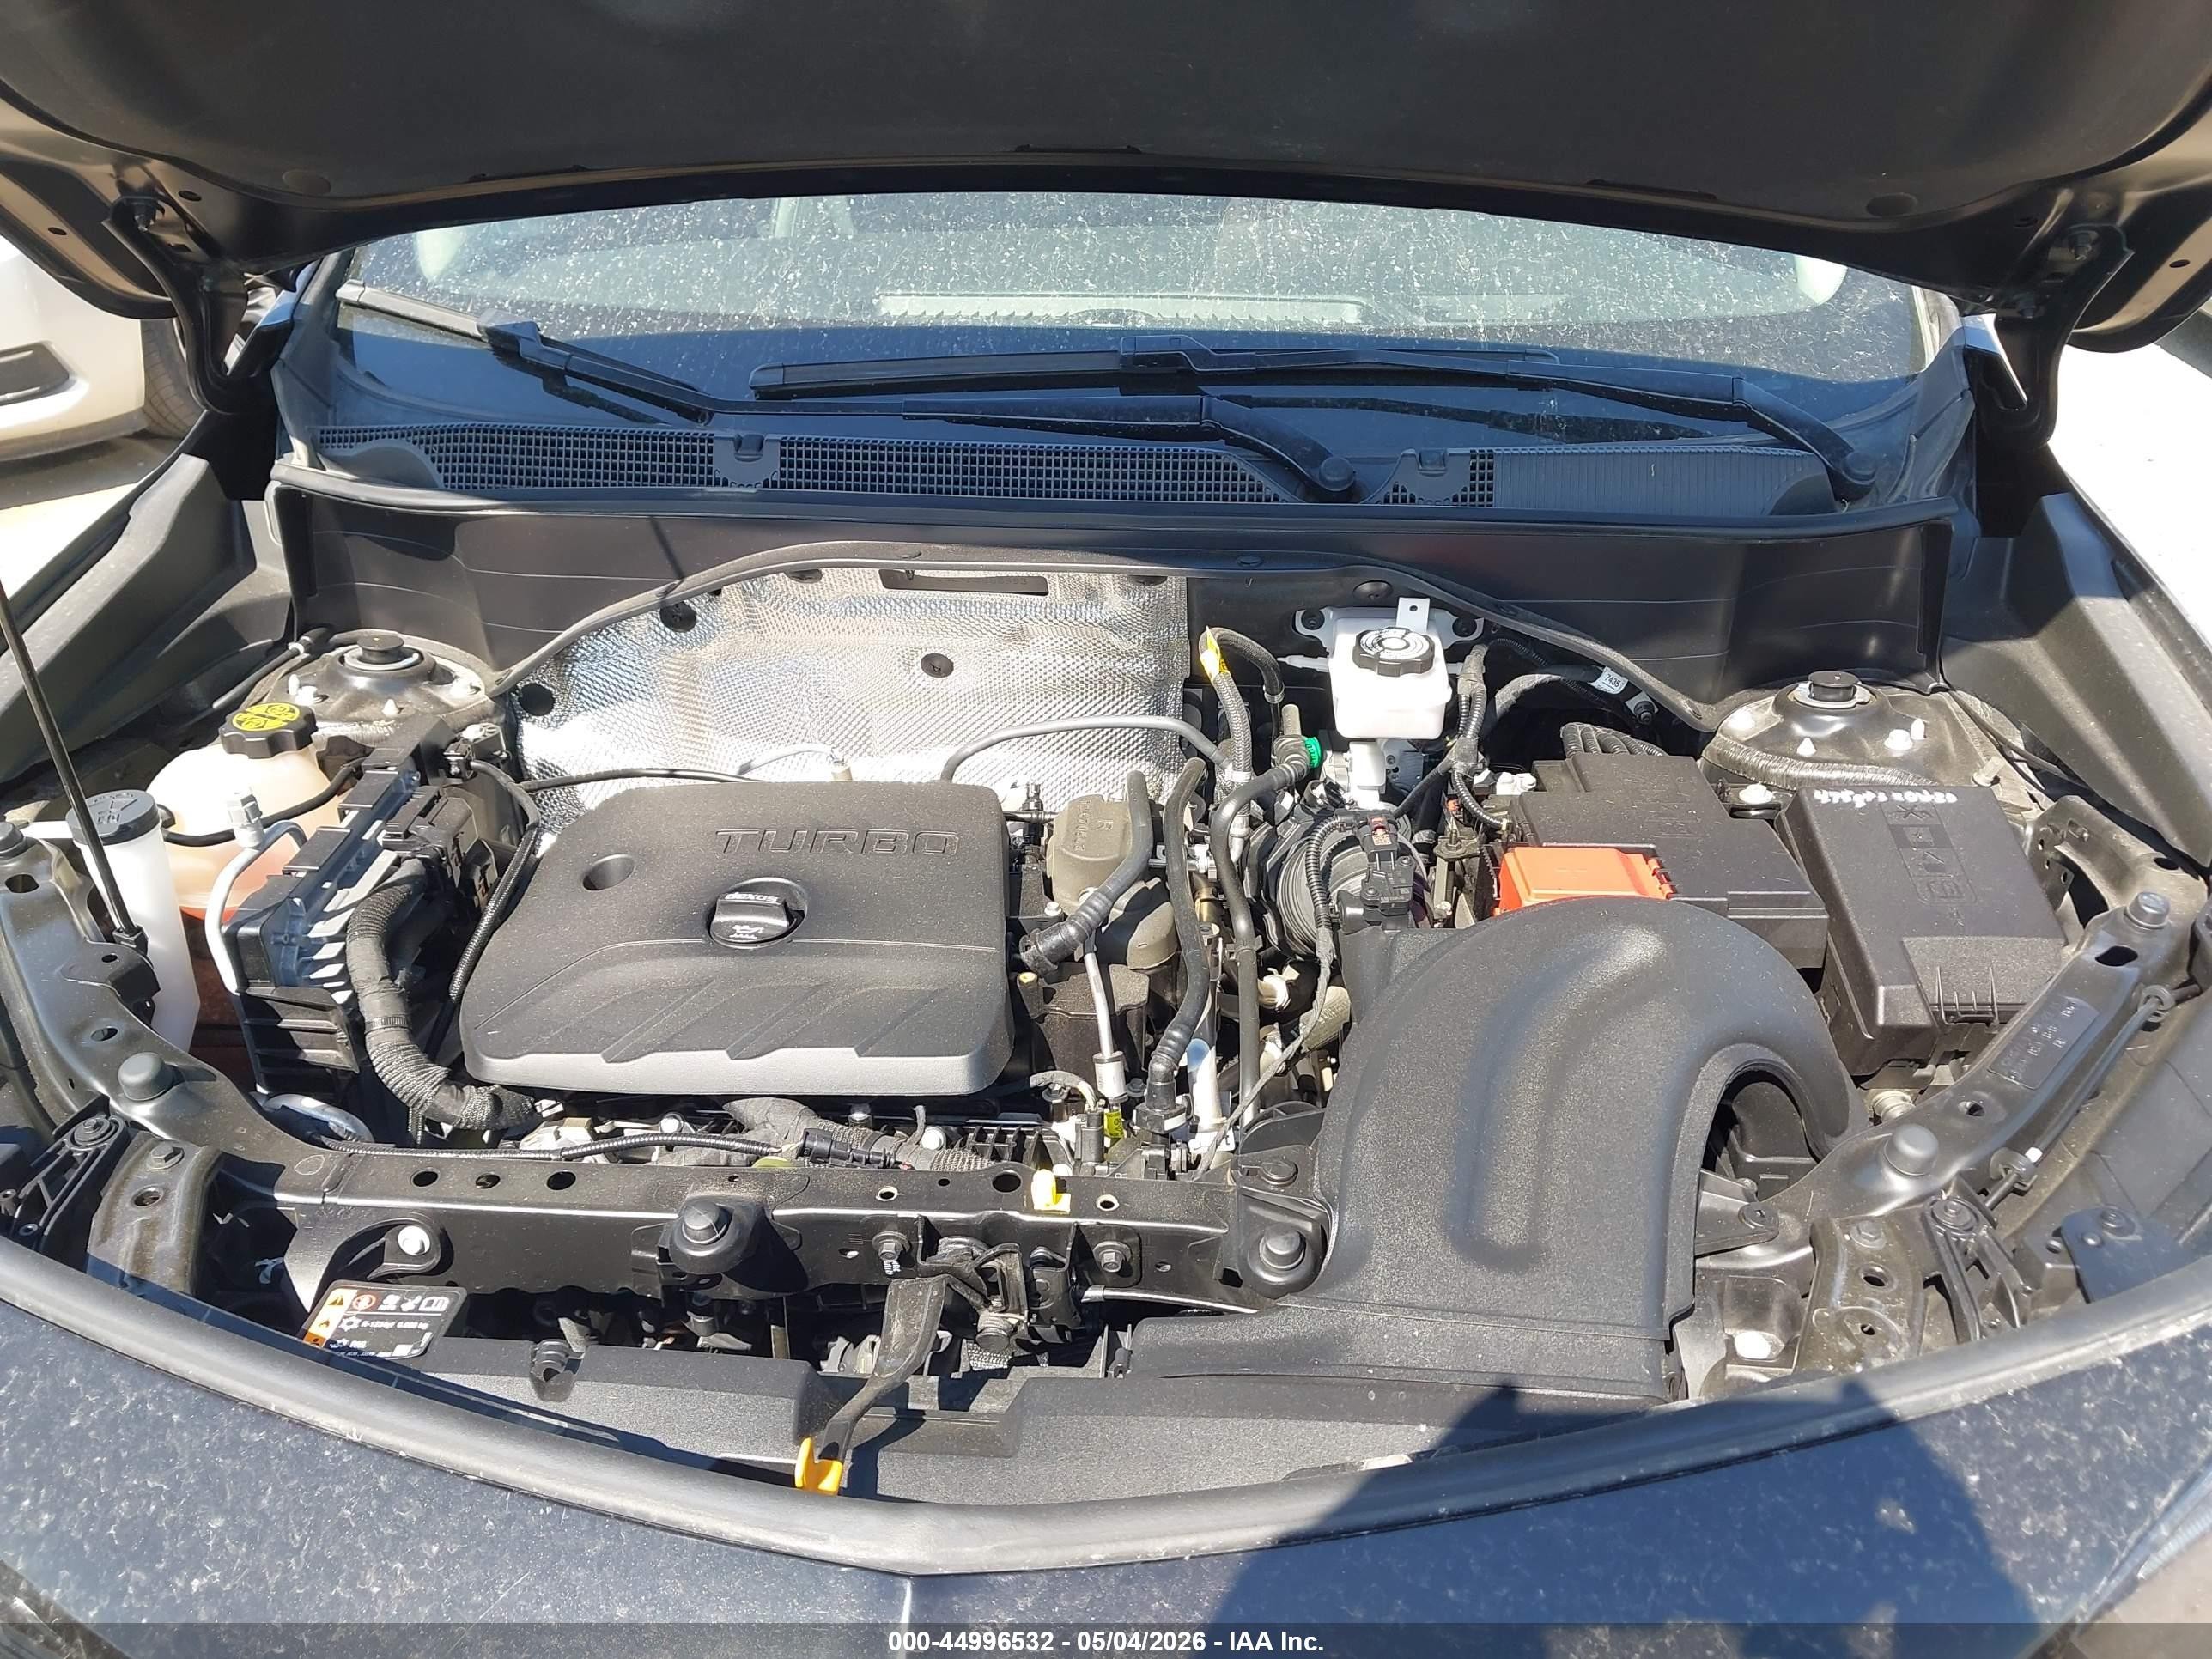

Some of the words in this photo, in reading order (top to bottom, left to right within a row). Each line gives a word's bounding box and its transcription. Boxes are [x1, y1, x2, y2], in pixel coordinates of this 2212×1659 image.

[1604, 673, 1621, 688] 7435
[715, 828, 960, 855] TURBO
[725, 891, 779, 902] dexos
